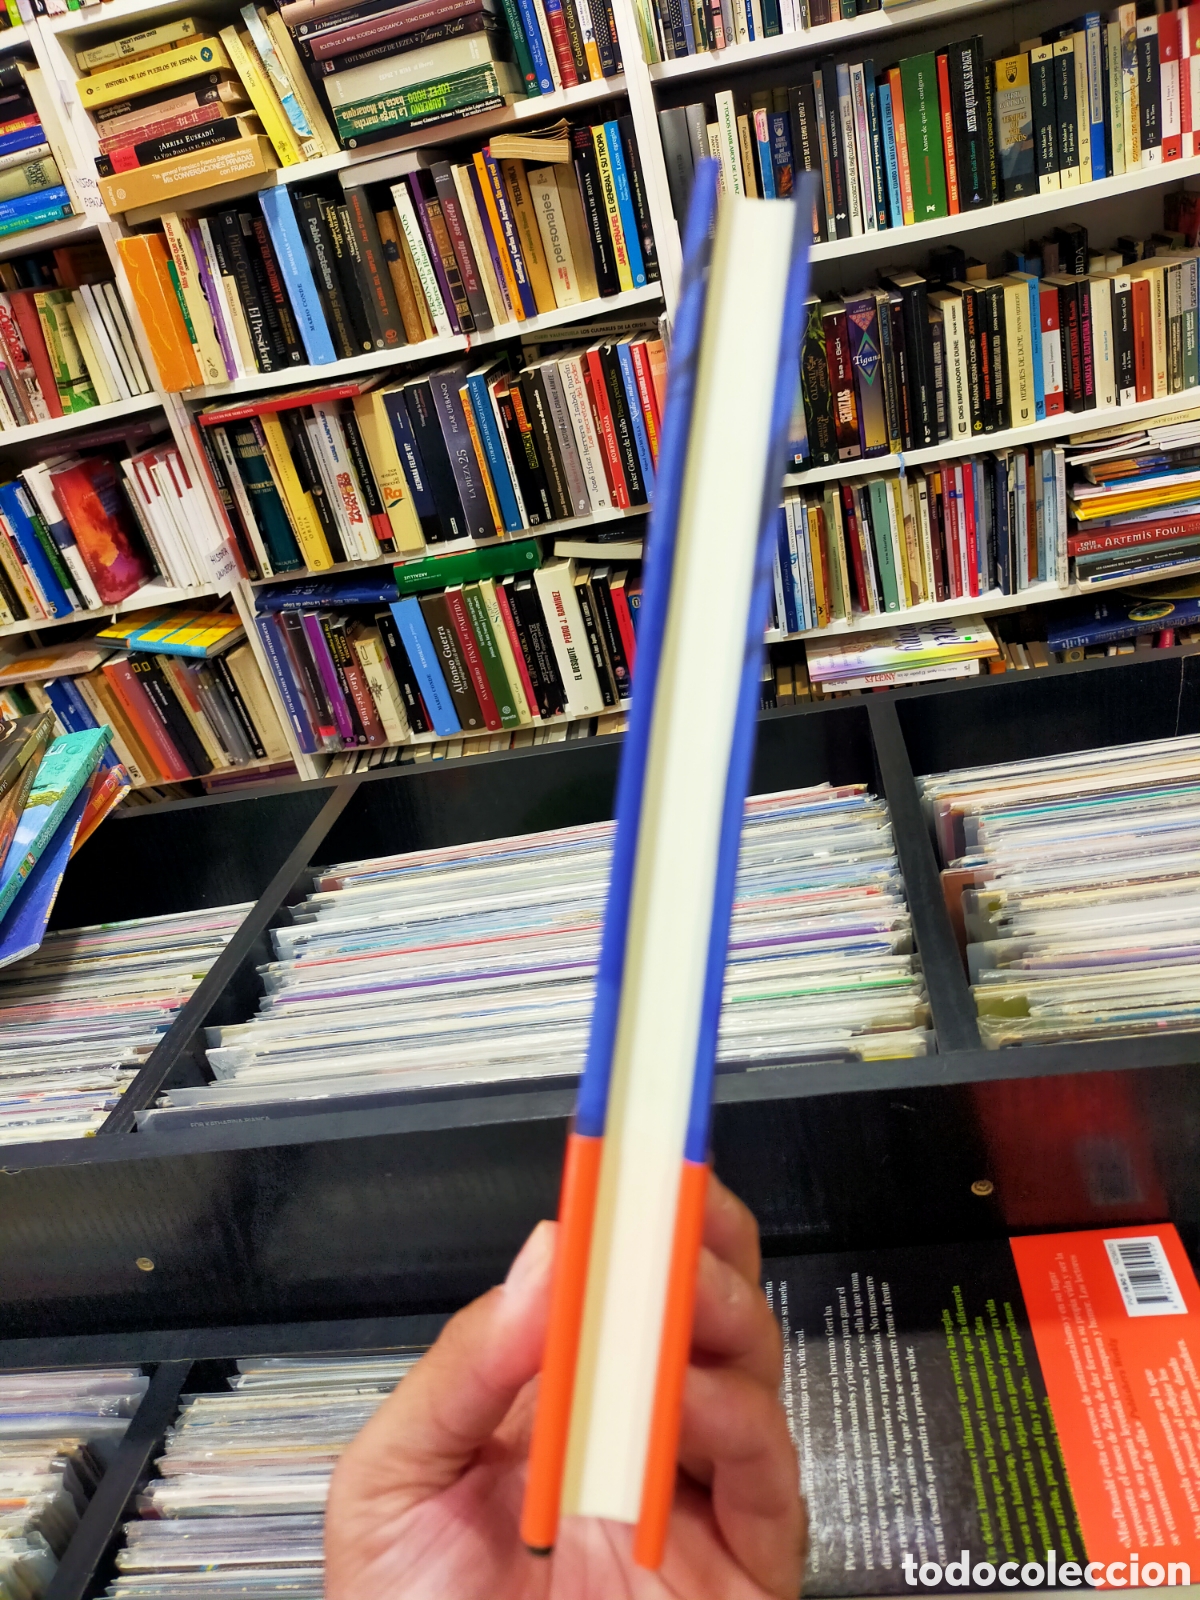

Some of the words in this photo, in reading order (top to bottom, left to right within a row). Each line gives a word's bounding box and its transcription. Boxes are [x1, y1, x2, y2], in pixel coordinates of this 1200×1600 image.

[357, 29, 377, 40] SOCIEDAD
[377, 20, 403, 33] GEOGRÁFICA
[405, 16, 419, 24] TOMO
[525, 10, 535, 37] Coronas
[565, 5, 576, 29] Colón
[570, 30, 584, 67] Cristóbal
[961, 49, 972, 72] APAGUE
[105, 75, 128, 89] HISTORIA
[147, 64, 169, 77] PUEBLOS
[179, 54, 198, 68] ESPAÑA
[917, 72, 926, 100] cuelguen
[410, 96, 447, 115] LAUREANO
[354, 114, 379, 129] marcha
[845, 120, 854, 140] origen
[967, 116, 978, 132] ANTES
[596, 133, 607, 156] TROPA
[610, 127, 619, 151] egregios
[726, 129, 735, 163] HABLARON
[921, 135, 929, 152] Antes
[174, 164, 226, 181] CONVERSACIONES
[226, 154, 254, 167] PRIVADAS
[231, 161, 256, 173] FRANCO
[614, 152, 622, 170] Locos
[847, 140, 856, 168] segundo
[507, 165, 524, 207] TREBLINKA
[584, 173, 594, 195] ROMA
[604, 174, 615, 204] GENERAL
[849, 177, 859, 217] Mecanoscrito
[165, 222, 174, 236] amor
[253, 221, 267, 243] CESAR
[541, 193, 565, 263] personajes
[591, 208, 602, 243] HISTORIA
[611, 214, 624, 245] PEÑAFIEL
[329, 228, 343, 258] Christopher
[401, 214, 421, 267] SEVILLANOS
[416, 239, 431, 268] Historia
[508, 237, 518, 254] Carlos
[175, 254, 188, 276] grandes
[286, 243, 298, 275] MEMORIAS
[617, 246, 627, 266] JAIME
[264, 259, 282, 293] AMBICION
[514, 259, 526, 284] Santiago
[297, 283, 309, 308] CONDE
[308, 217, 321, 244] Pablo
[315, 244, 333, 289] Castellano
[338, 322, 353, 357] acuerdo
[418, 268, 439, 318] PERSONAJES
[966, 295, 974, 317] VARLEY
[305, 309, 316, 332] MARIO
[590, 325, 618, 334] CULPABLES
[251, 319, 272, 371] Presidente
[1082, 320, 1091, 355] ULTRATUMBA
[564, 364, 575, 393] Durán
[571, 362, 581, 385] poder
[610, 369, 622, 399] perdidos
[955, 367, 963, 405] EMPERADOR
[1018, 368, 1027, 402] HEREJES
[1084, 364, 1093, 396] VENGANZAS
[440, 383, 454, 413] URBANO
[510, 387, 532, 432] PERESTROIKA
[570, 394, 581, 417] Isabel
[972, 384, 980, 409] MAÑANA
[448, 415, 459, 433] PILAR
[580, 401, 592, 434] secretos
[603, 415, 613, 433] ROJA
[619, 418, 630, 438] Liaño
[485, 435, 497, 463] FEDERICO
[577, 425, 591, 456] Herrera
[607, 433, 618, 464] MORFINA
[407, 451, 417, 467] FELIPE
[457, 449, 469, 464] 25
[625, 448, 637, 472] Gómez
[462, 464, 474, 487] PIEZA
[1105, 531, 1151, 547] ARTEMIS
[1155, 524, 1187, 538] FOWL
[452, 598, 468, 631] PARTIDA
[551, 591, 565, 616] RAMÍREZ
[261, 622, 276, 655] HISTÓRICOS
[436, 625, 452, 658] Guerra
[561, 625, 572, 644] PEDRO
[467, 640, 478, 663] FINAL
[567, 647, 580, 673] DESQUITE
[271, 656, 284, 676] MUSEOS
[449, 660, 465, 694] Alfonso
[279, 677, 292, 702] GRANDES
[778, 1280, 788, 1305] sueño:
[850, 1272, 859, 1292] toma
[880, 1282, 892, 1305] frente
[839, 1296, 850, 1318] ganar
[866, 1276, 878, 1317] transcurre
[952, 1285, 967, 1325] diferencia
[825, 1318, 834, 1336] Gert
[941, 1308, 954, 1334] reglas
[1003, 1302, 1021, 1340] podemos
[795, 1329, 805, 1347] real.
[872, 1332, 884, 1362] misión.
[797, 1348, 806, 1367] vida
[827, 1337, 838, 1375] hermano
[843, 1339, 856, 1384] peligrosos
[859, 1345, 869, 1368] flote,
[889, 1339, 902, 1382] encuentre
[905, 1346, 916, 1370] valor.
[950, 1350, 963, 1385] revierte
[979, 1337, 998, 1389] superpoder.
[1013, 1341, 1026, 1366] todos
[1062, 1322, 1088, 1393] sentimentalismo
[1083, 1345, 1097, 1370] forma
[783, 1353, 793, 1391] mientras
[877, 1364, 890, 1393] propia
[912, 1384, 926, 1416] prueba
[968, 1365, 983, 1409] momento
[799, 1391, 810, 1425] vikinga
[862, 1377, 876, 1430] mantenerse
[897, 1396, 909, 1421] Zelda
[1099, 1402, 1114, 1430] Zelda
[832, 1407, 845, 1451] descubre
[847, 1393, 862, 1458] cuestionables
[882, 1408, 896, 1459] emprender
[960, 1404, 976, 1449] hilarante
[917, 1426, 934, 1461] pondrá
[836, 1453, 847, 1481] Zelda
[905, 1457, 916, 1486] antes
[854, 1459, 867, 1505] métodos
[872, 1457, 885, 1506] necesitan
[971, 1459, 987, 1510] luminoso
[838, 1481, 851, 1522] cuando
[911, 1487, 922, 1526] tiempo
[927, 1484, 941, 1524] desafío
